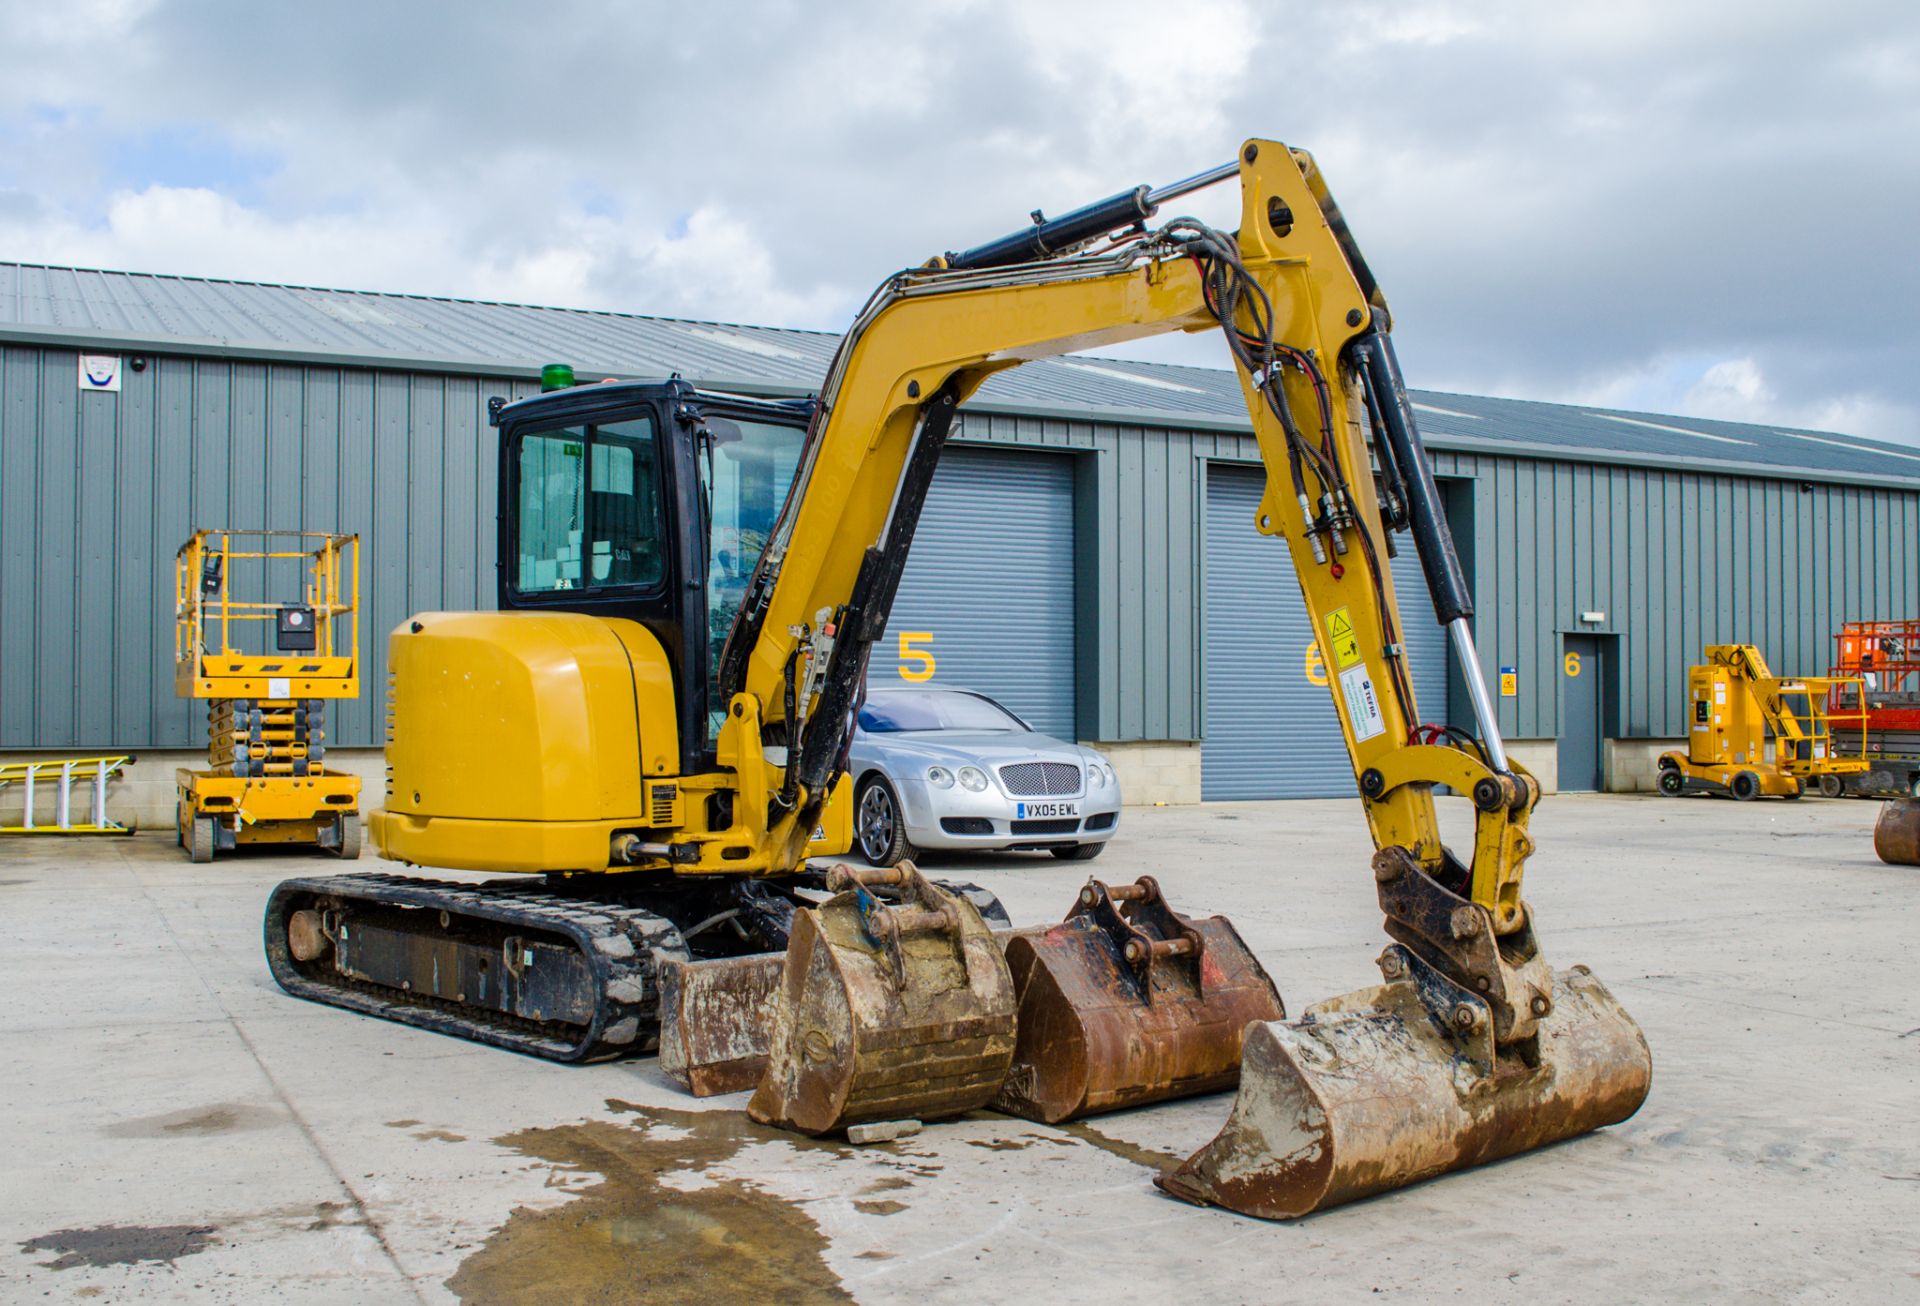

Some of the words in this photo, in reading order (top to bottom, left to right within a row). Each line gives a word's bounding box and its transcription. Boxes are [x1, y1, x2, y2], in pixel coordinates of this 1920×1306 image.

[898, 632, 936, 683] 5
[1305, 639, 1329, 687] 6
[1565, 651, 1581, 677] 6
[1365, 690, 1377, 719] TEFRA
[1026, 804, 1057, 817] VX05
[1059, 803, 1078, 815] EWL
